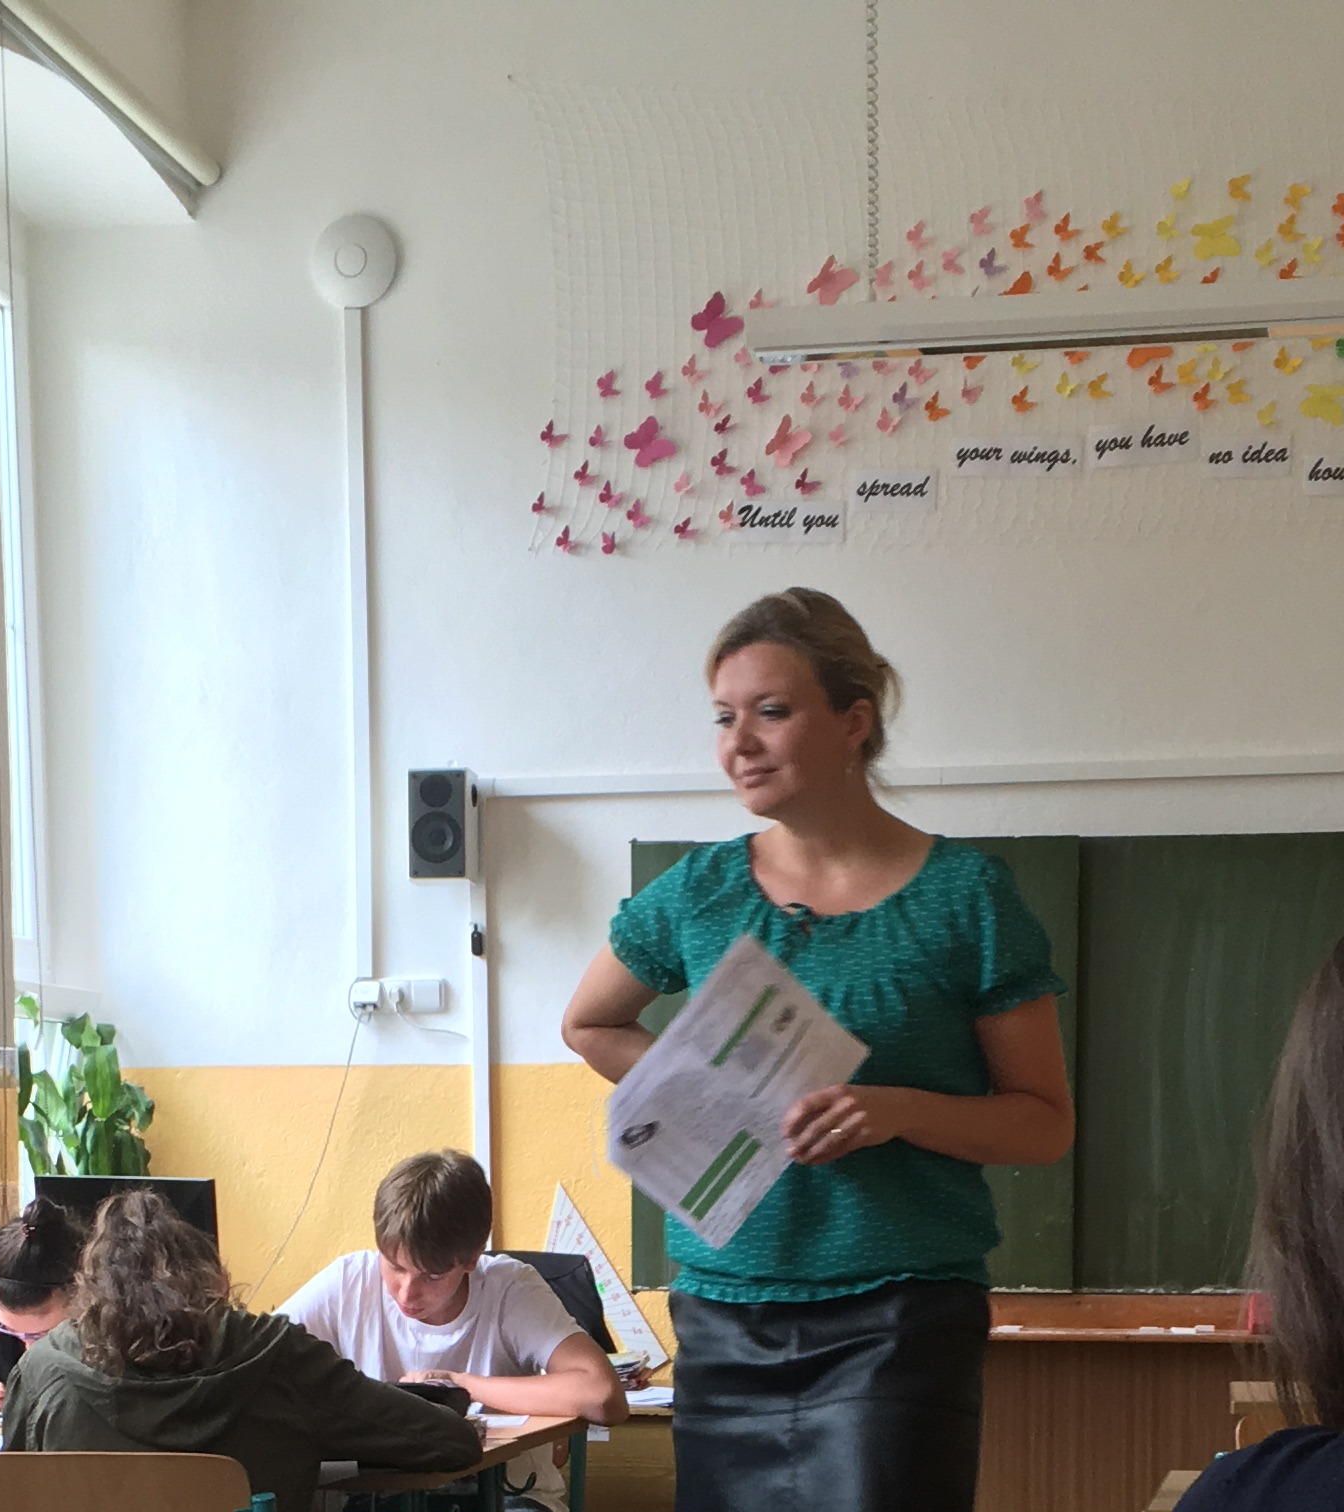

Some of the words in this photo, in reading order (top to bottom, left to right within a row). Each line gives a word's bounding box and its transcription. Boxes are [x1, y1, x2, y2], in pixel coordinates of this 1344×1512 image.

[1095, 435, 1133, 460] you
[1141, 424, 1190, 448] have
[1208, 449, 1234, 465] no
[1241, 441, 1290, 463] idea
[956, 446, 1003, 468] your
[856, 476, 930, 503] spread
[737, 504, 798, 528] Until
[802, 513, 840, 535] you
